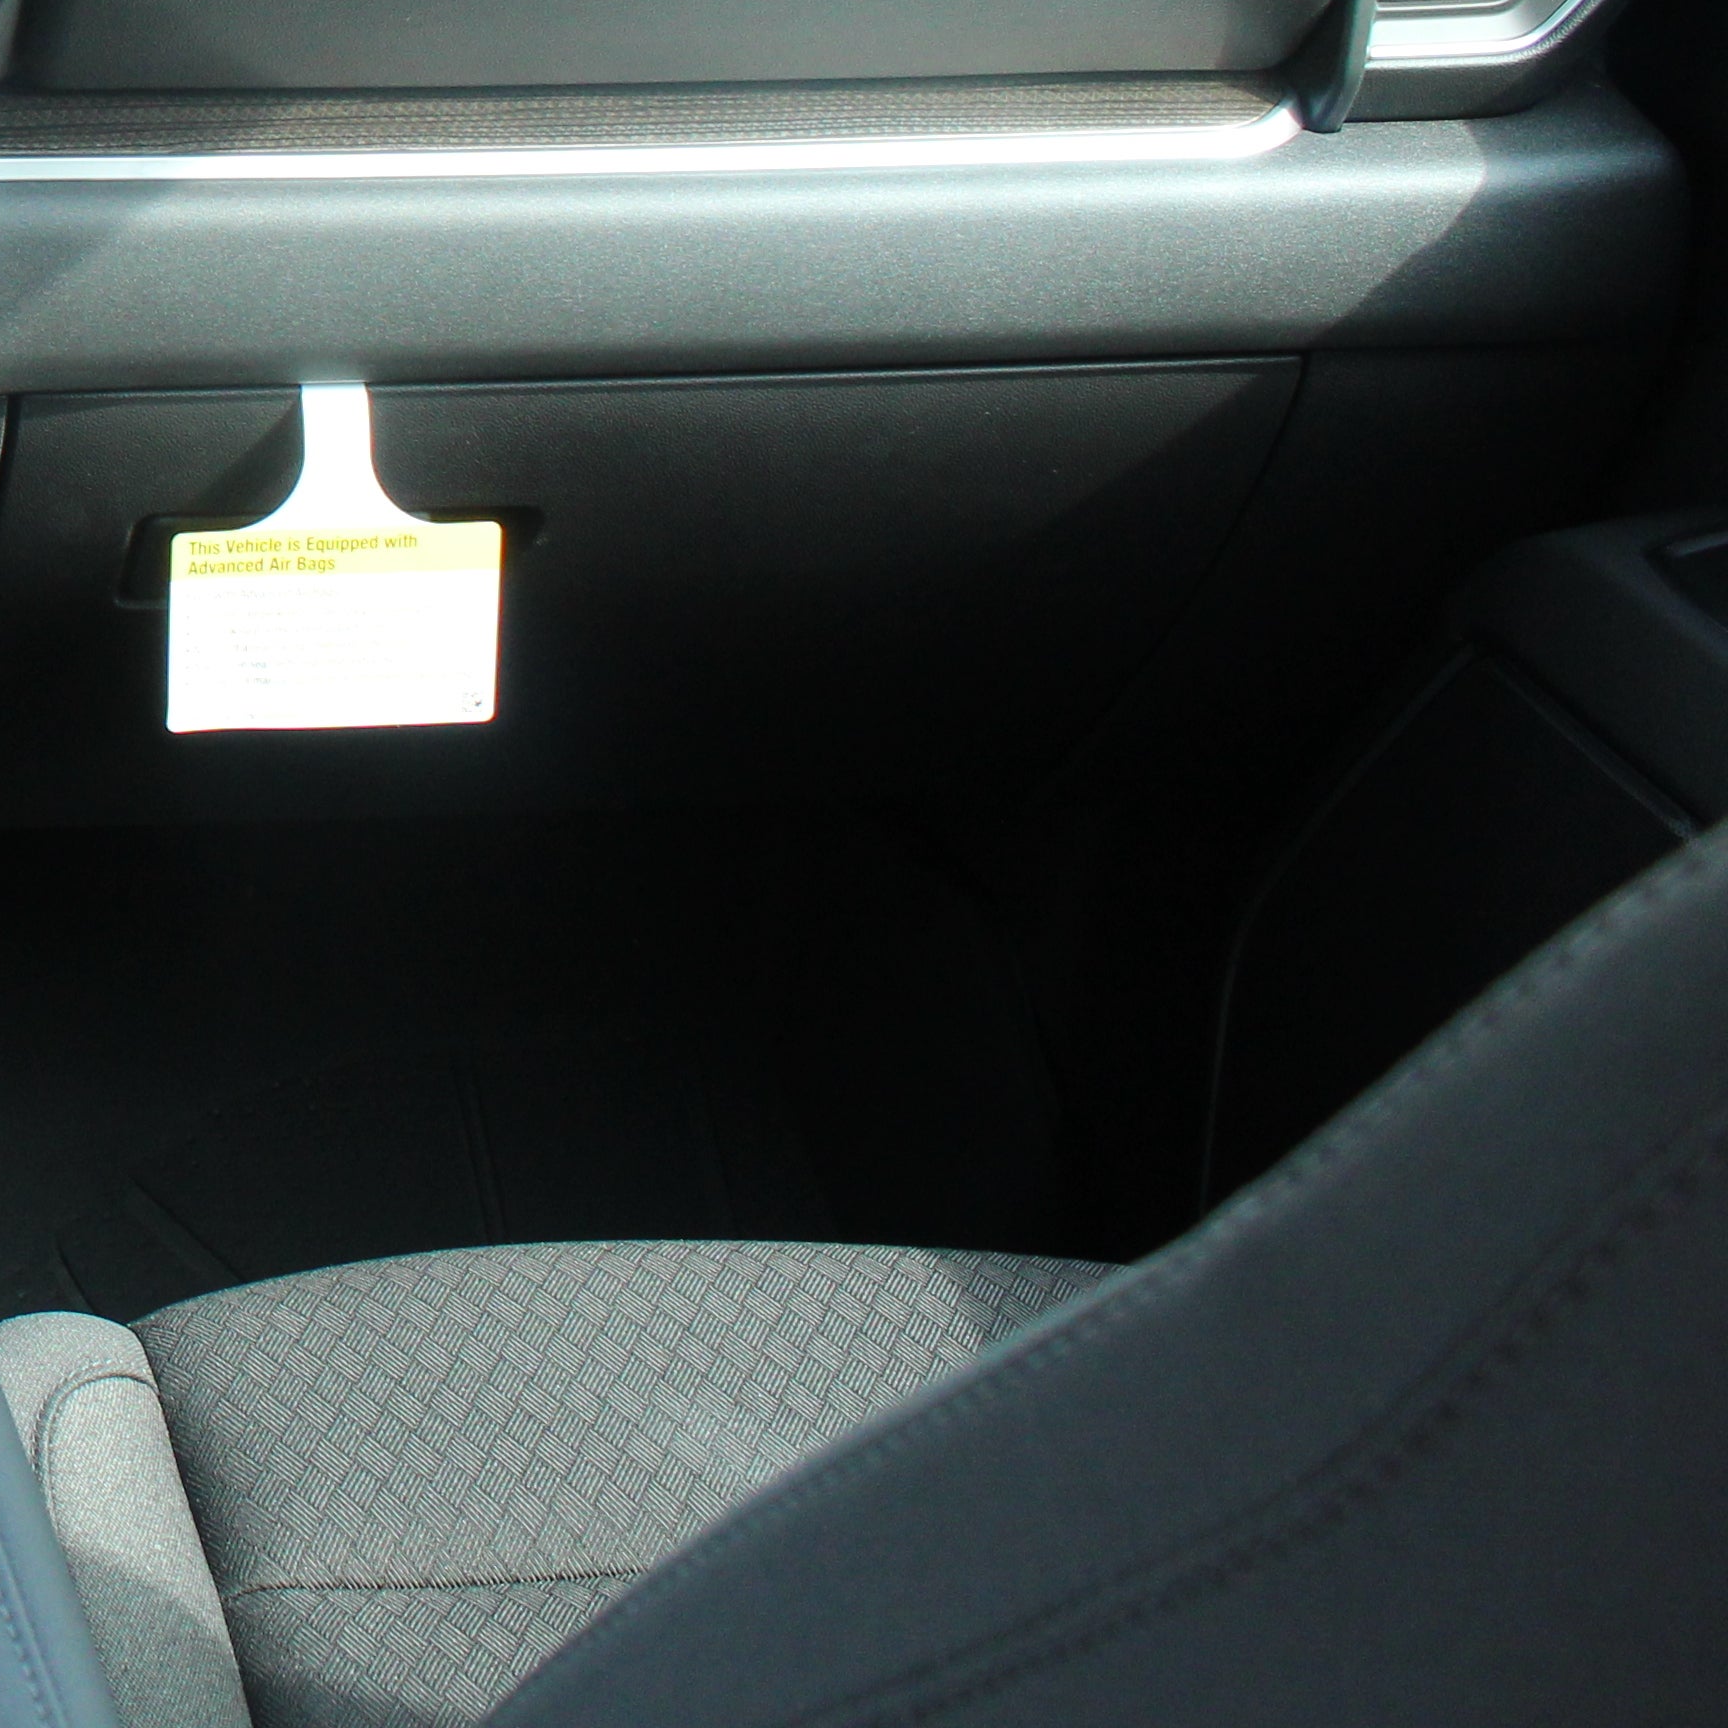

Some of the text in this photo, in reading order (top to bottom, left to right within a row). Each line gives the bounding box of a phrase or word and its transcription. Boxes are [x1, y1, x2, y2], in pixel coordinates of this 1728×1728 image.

[190, 535, 417, 555] This Vehicle is Equipped with
[188, 557, 335, 575] Advanced Air Bags
